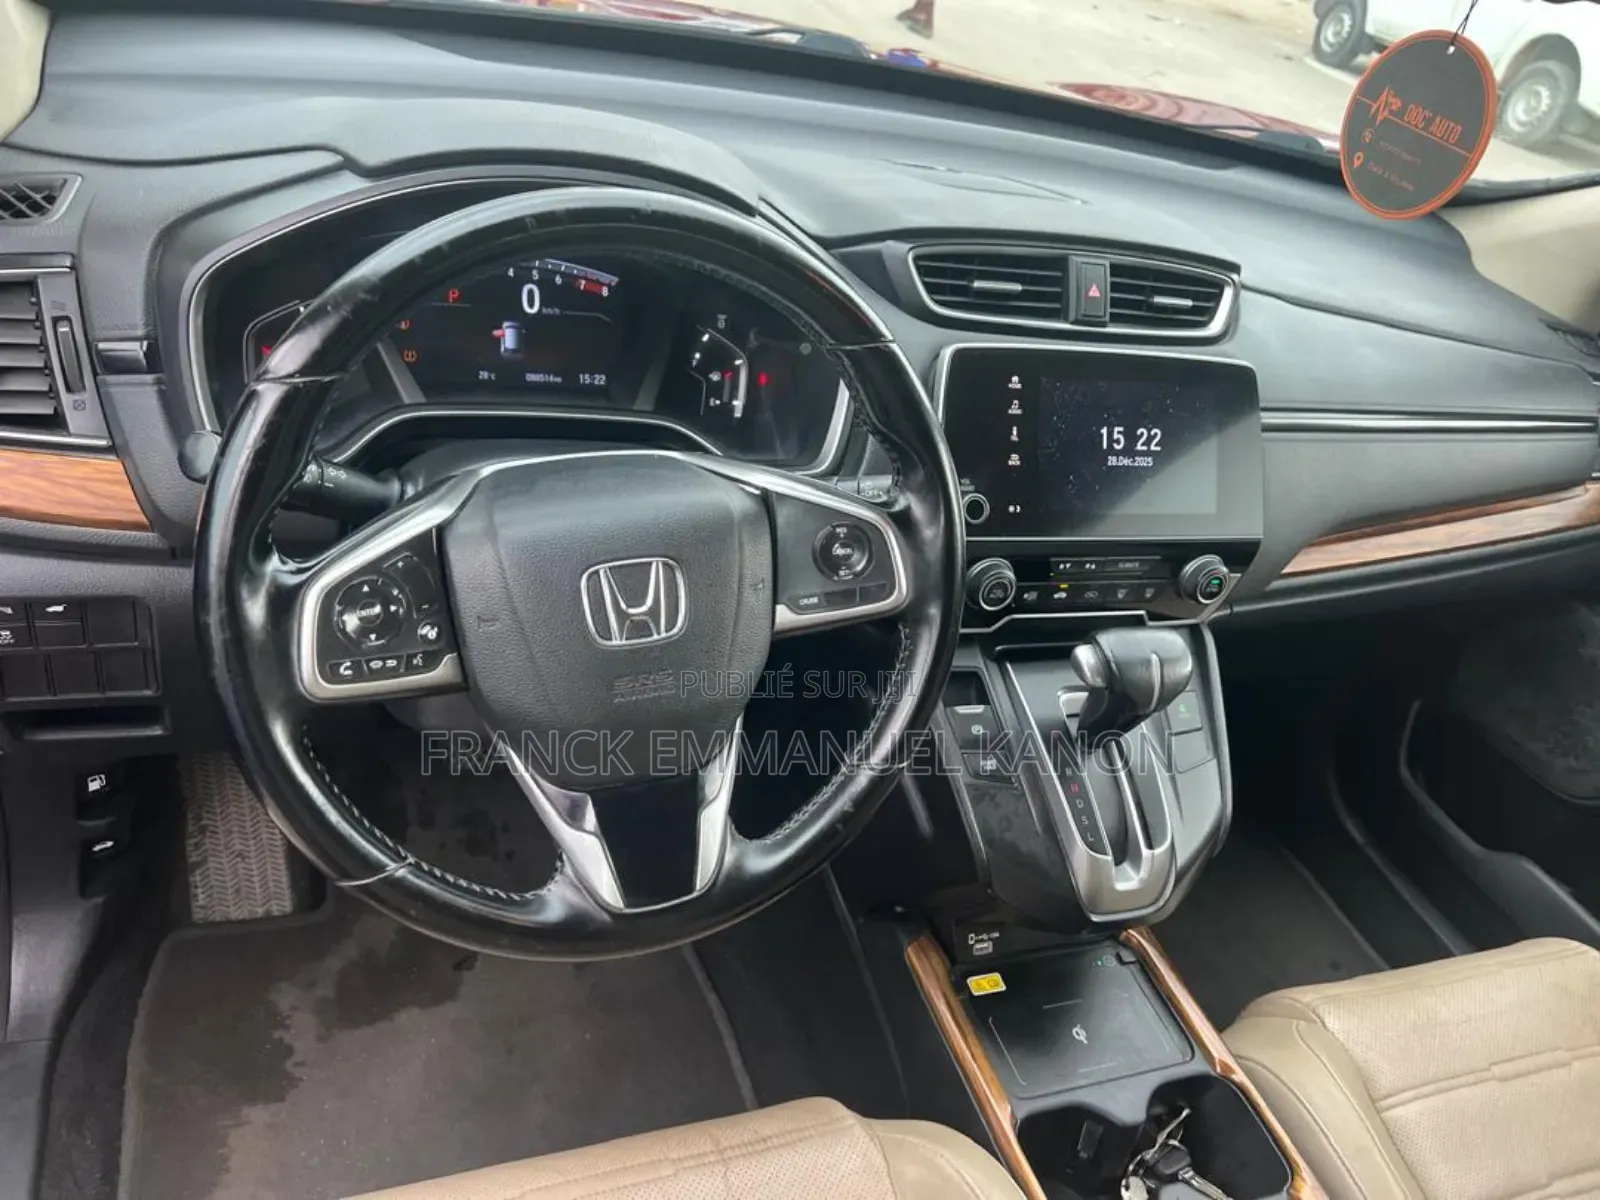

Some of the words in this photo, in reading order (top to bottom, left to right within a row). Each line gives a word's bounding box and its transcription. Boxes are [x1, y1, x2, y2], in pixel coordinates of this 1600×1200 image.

[1430, 116, 1462, 143] AUTO
[507, 267, 515, 278] 4
[531, 269, 539, 280] 5
[555, 274, 563, 285] 6
[580, 279, 587, 290] 7
[601, 286, 609, 297] 8
[521, 283, 540, 314] 0
[579, 373, 606, 385] 15:22
[1100, 426, 1125, 450] 15
[1135, 427, 1162, 451] 22
[1075, 799, 1085, 809] D
[1081, 816, 1090, 826] S
[1086, 832, 1096, 842] L
